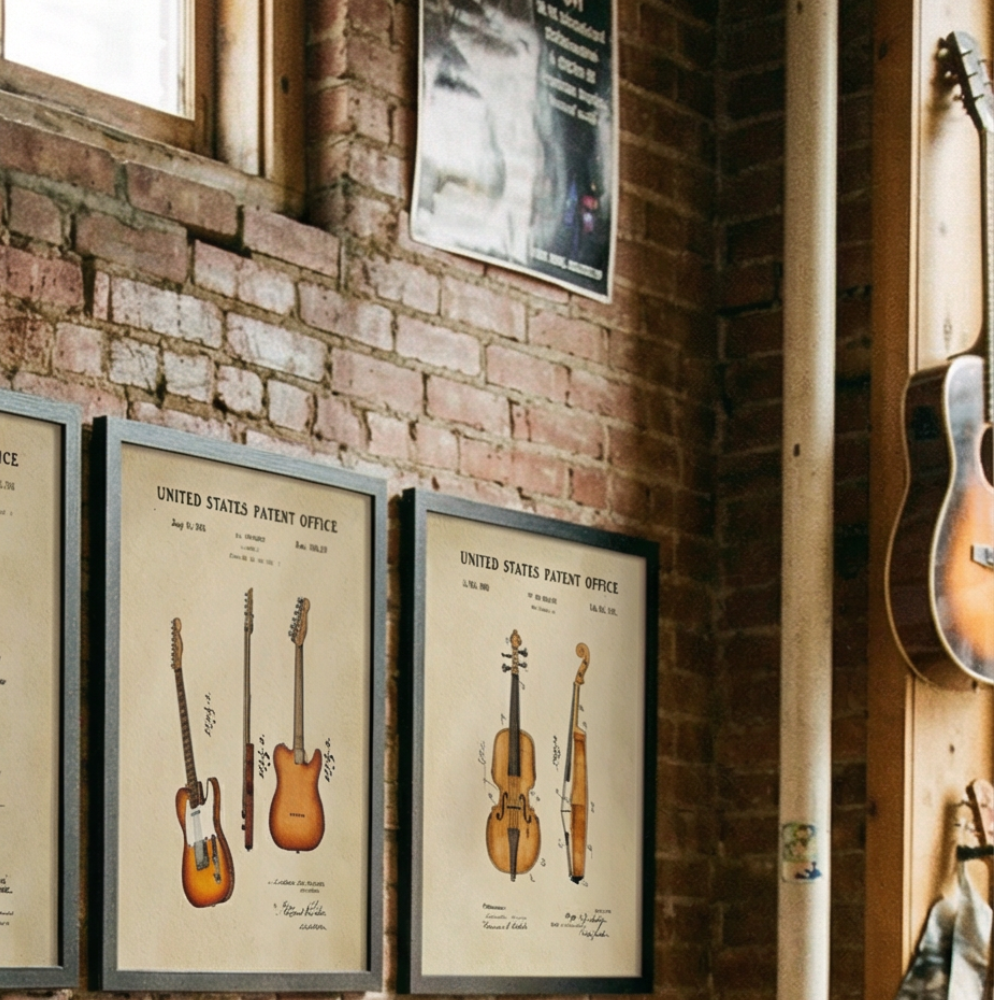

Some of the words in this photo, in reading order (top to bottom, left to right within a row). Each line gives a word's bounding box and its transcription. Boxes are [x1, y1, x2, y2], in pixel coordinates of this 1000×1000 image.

[157, 486, 202, 507] UNITED
[206, 495, 248, 516] STATES
[254, 505, 295, 525] PATENT
[300, 514, 338, 533] OFFICE
[460, 551, 499, 570] UNITED
[503, 560, 540, 579] STATES
[544, 568, 581, 587] PATENT
[585, 577, 619, 594] OFFICE
